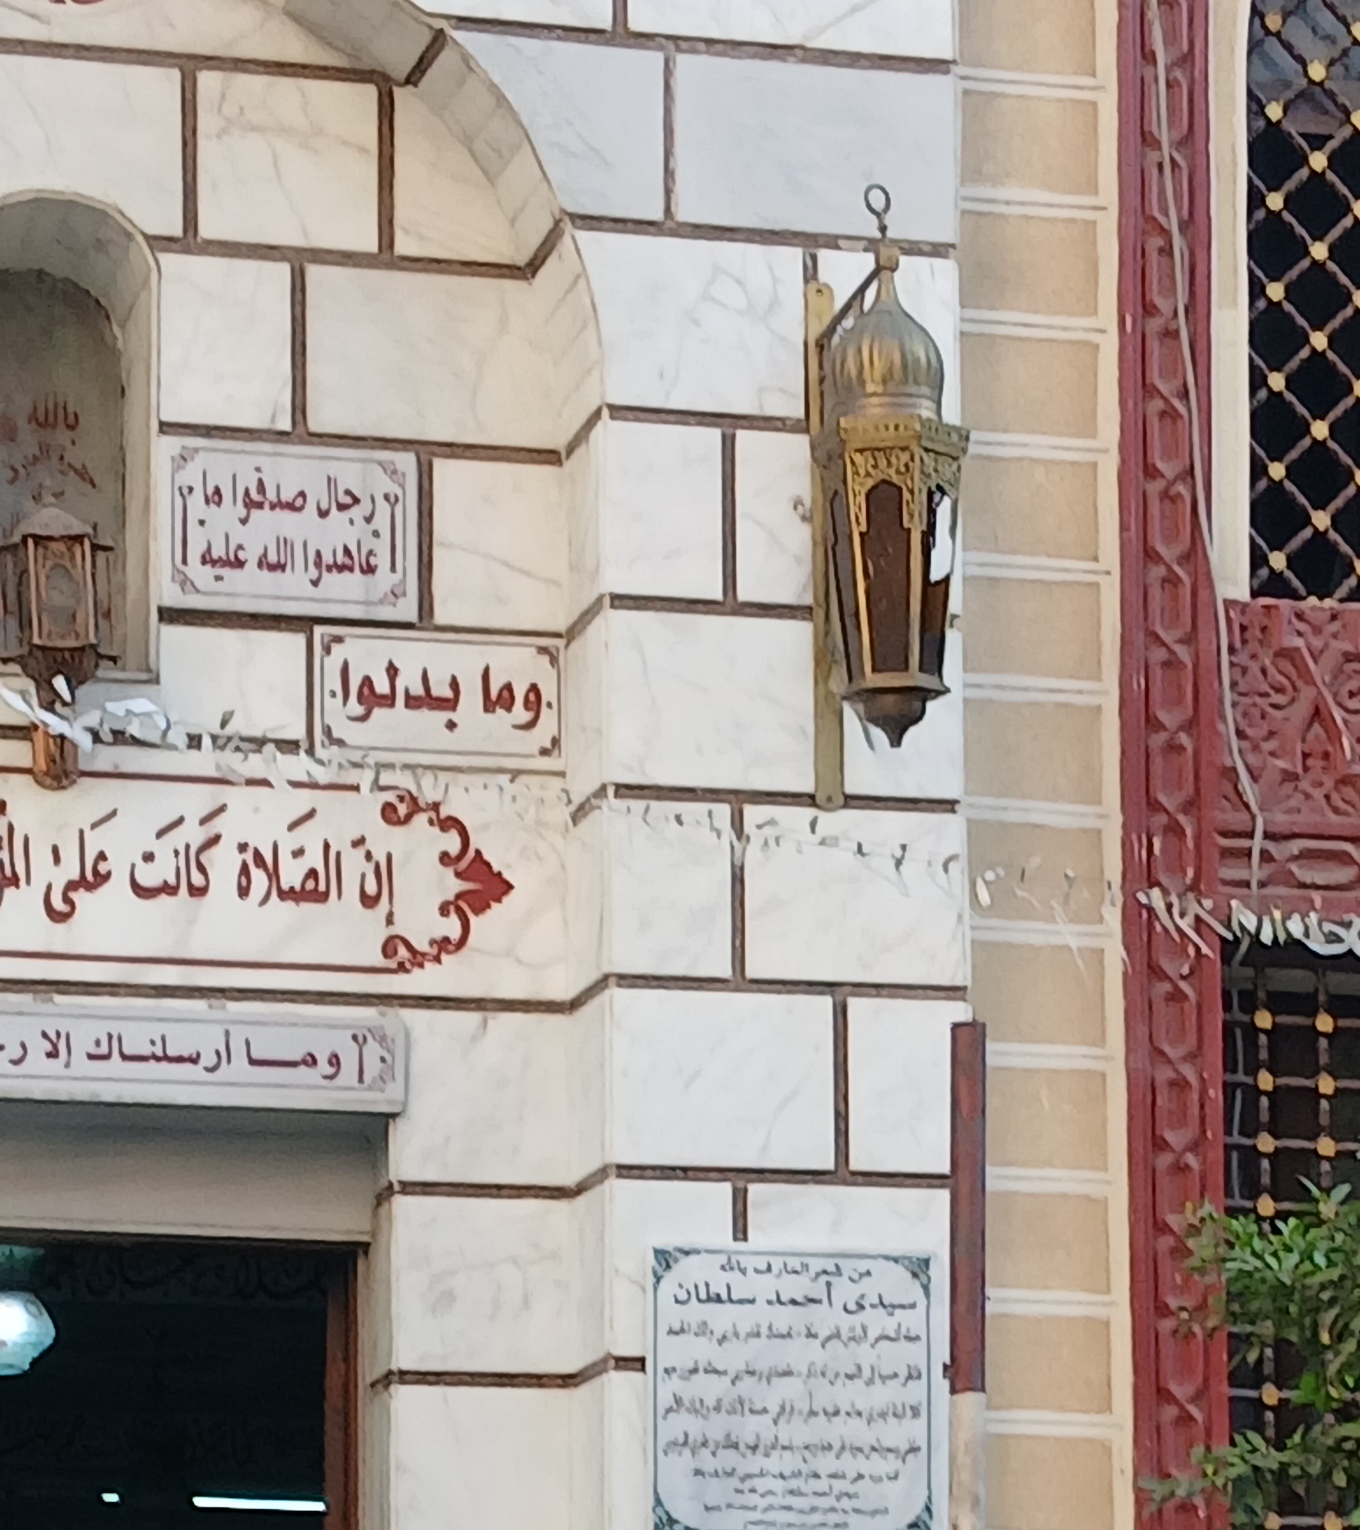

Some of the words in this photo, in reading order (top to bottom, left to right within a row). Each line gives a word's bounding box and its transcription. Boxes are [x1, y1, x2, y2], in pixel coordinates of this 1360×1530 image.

[201, 468, 224, 509] ما
[231, 466, 308, 527] صدقوا
[316, 474, 377, 526] رجال
[200, 531, 249, 583] عليه
[256, 535, 296, 575] الله
[302, 538, 379, 588] عاهدوا
[340, 657, 462, 733] بدلوا
[481, 662, 543, 731] وما
[244, 1037, 343, 1081] وما
[672, 1280, 757, 1306] سلطان
[848, 1267, 873, 1284] من
